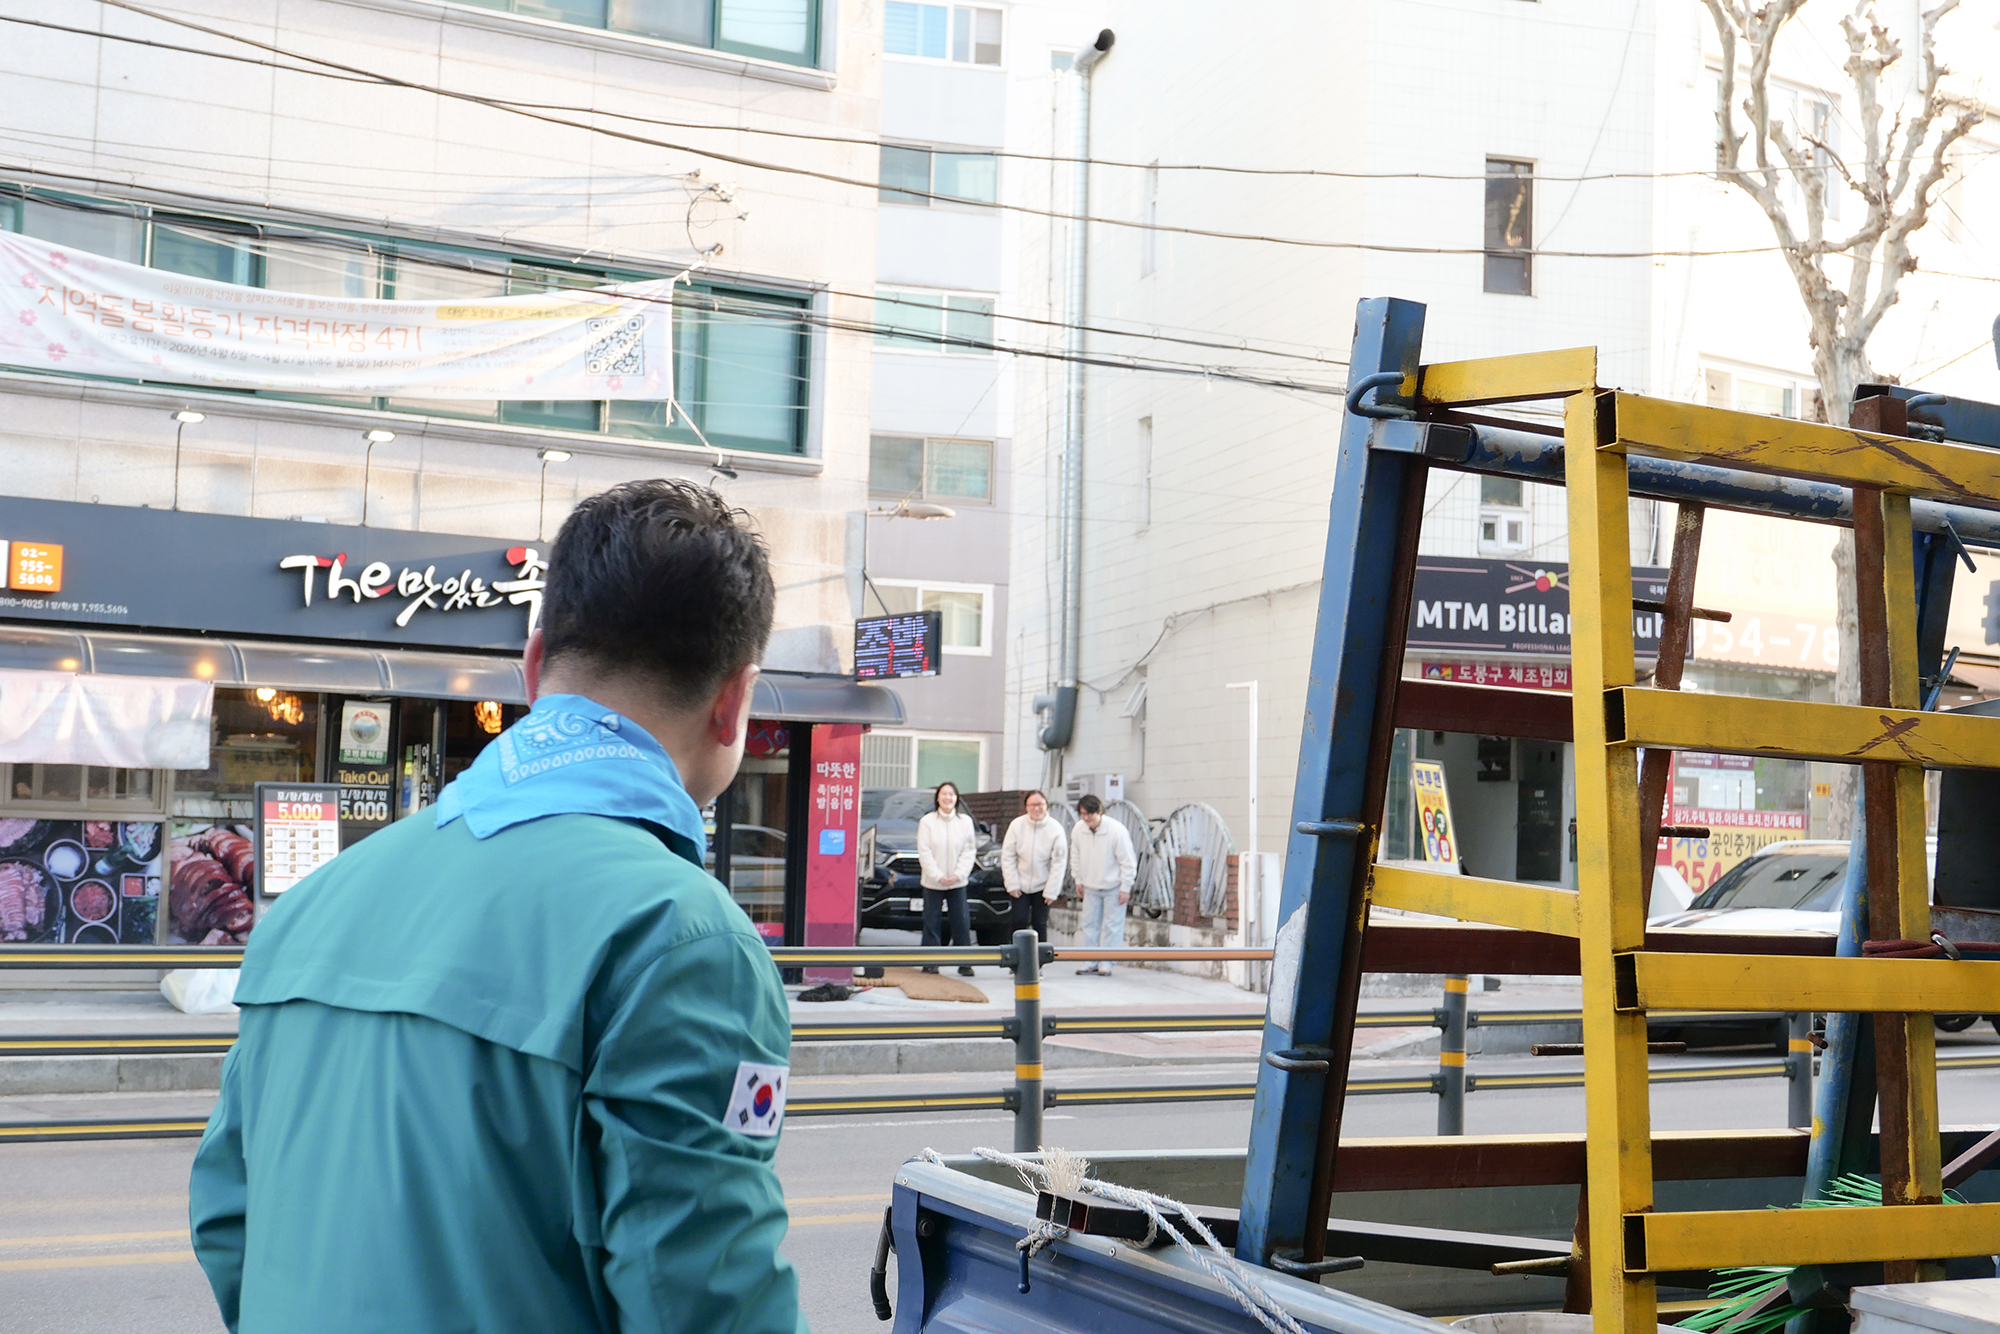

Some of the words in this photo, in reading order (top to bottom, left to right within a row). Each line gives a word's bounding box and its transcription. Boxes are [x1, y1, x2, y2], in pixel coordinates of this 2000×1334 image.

[37, 284, 244, 341] 지역돌봄활동가
[254, 314, 367, 353] 자격과정
[375, 325, 422, 353] 4기
[169, 341, 208, 357] 2026년
[210, 347, 228, 359] 4월
[20, 547, 48, 558] 02-
[19, 559, 54, 573] 955-
[18, 572, 54, 586] 5604
[279, 551, 396, 608] The
[1416, 599, 1489, 632] MTM
[1457, 661, 1503, 684] 도봉구
[338, 769, 366, 784] Take
[367, 770, 390, 785] Out
[816, 761, 856, 780] 따뜻한
[816, 784, 827, 810] 족발
[830, 784, 840, 811] 마음
[843, 784, 854, 811] 사람
